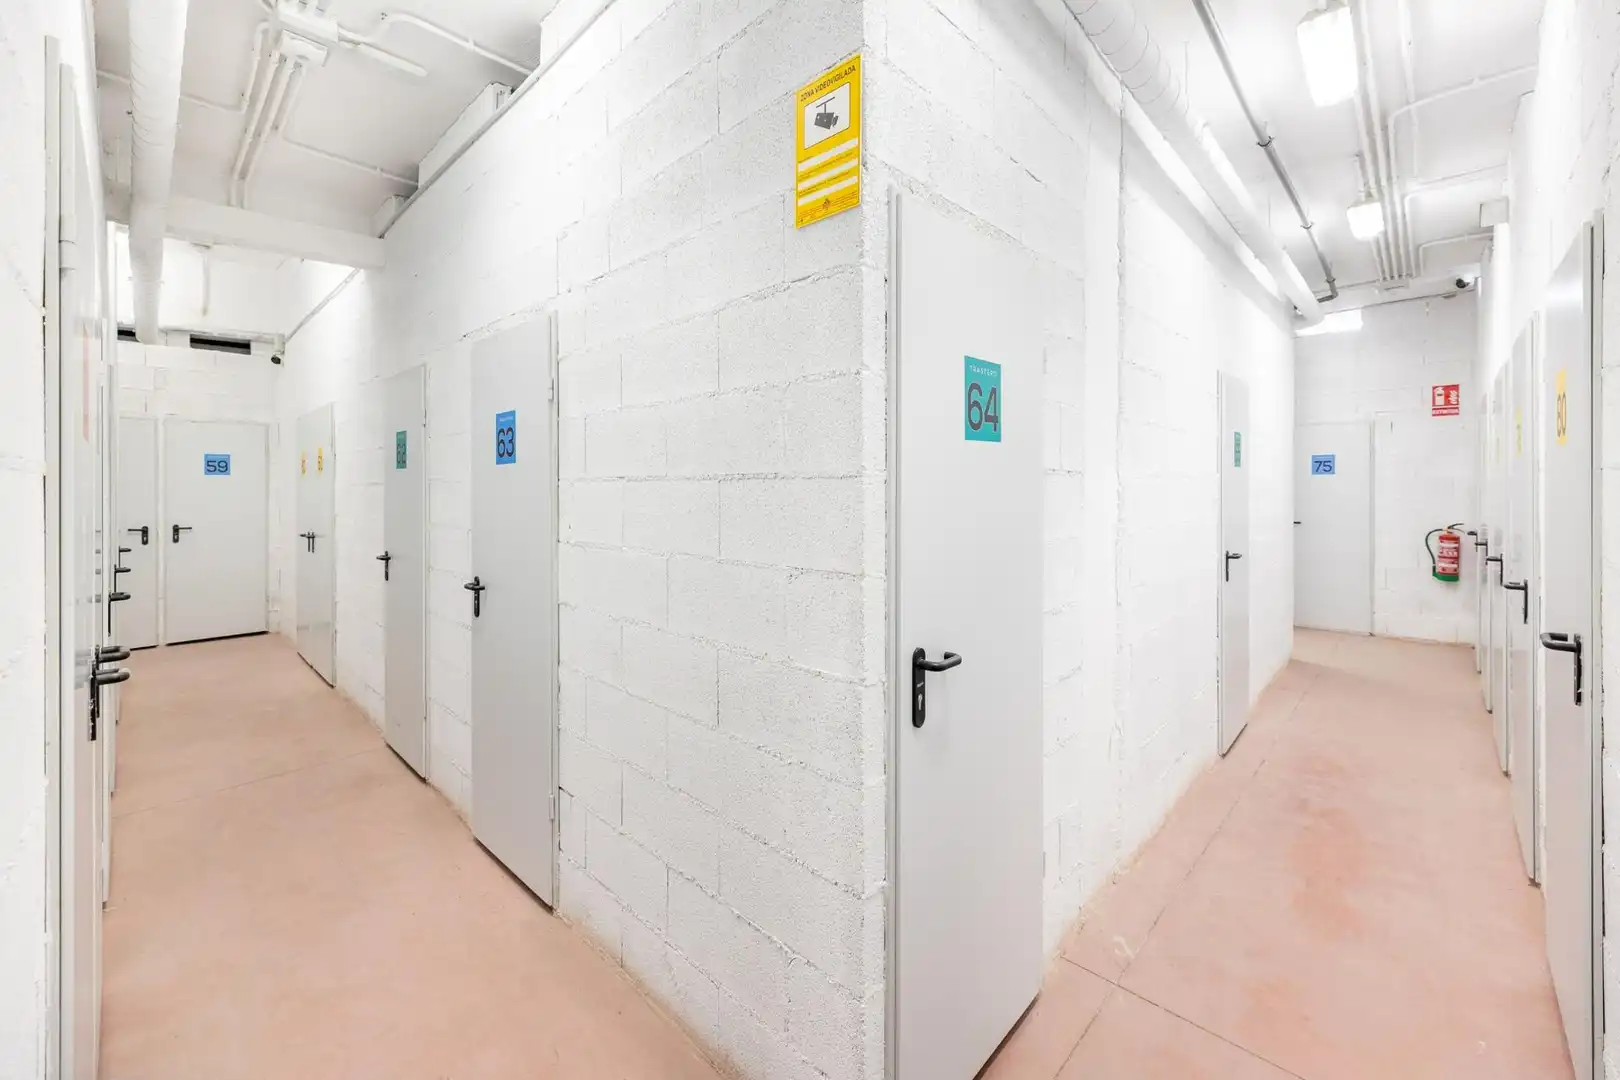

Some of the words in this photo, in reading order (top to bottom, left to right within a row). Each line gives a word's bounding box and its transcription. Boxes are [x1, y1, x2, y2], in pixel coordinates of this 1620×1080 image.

[800, 88, 815, 102] ZONA
[815, 65, 856, 93] VIDEOVIGILADA
[968, 382, 998, 432] 64
[1556, 391, 1567, 438] 80
[498, 427, 514, 458] 63
[206, 460, 228, 472] 59
[1313, 460, 1332, 472] 75
